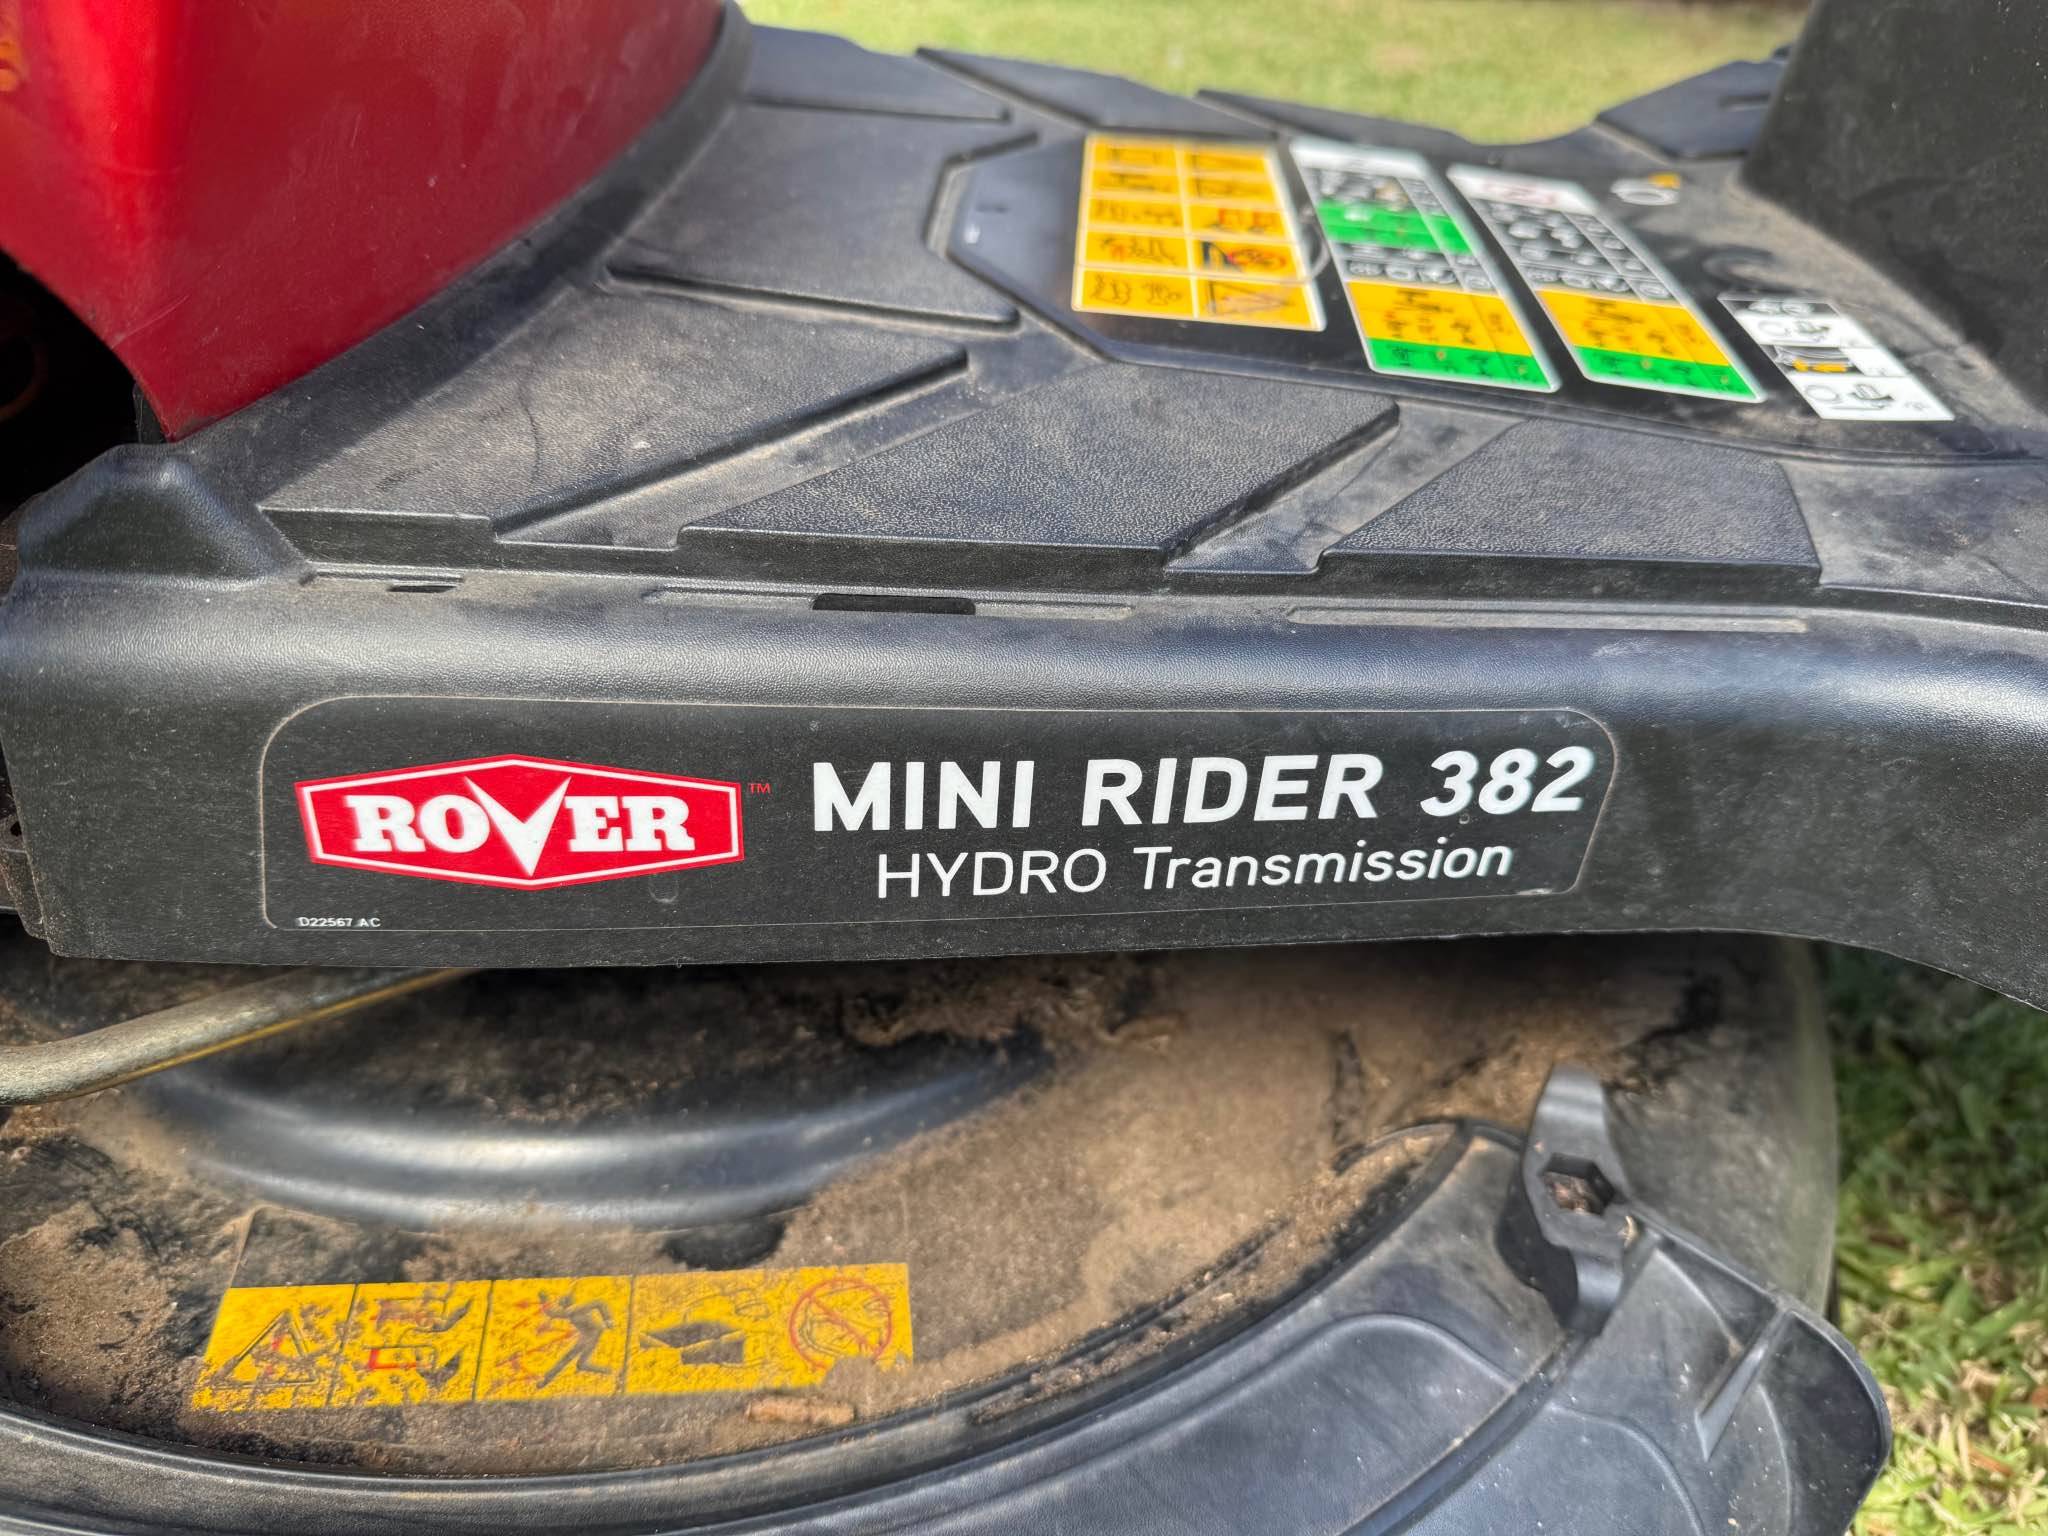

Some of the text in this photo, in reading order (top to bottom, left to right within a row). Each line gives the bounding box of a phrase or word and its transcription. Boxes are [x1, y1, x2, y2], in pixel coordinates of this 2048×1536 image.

[812, 746, 1596, 831] MINI RIDER 382
[346, 776, 696, 877] ROVER
[877, 836, 1513, 899] HYDRO Transmission
[298, 916, 381, 928] D22567 AC
